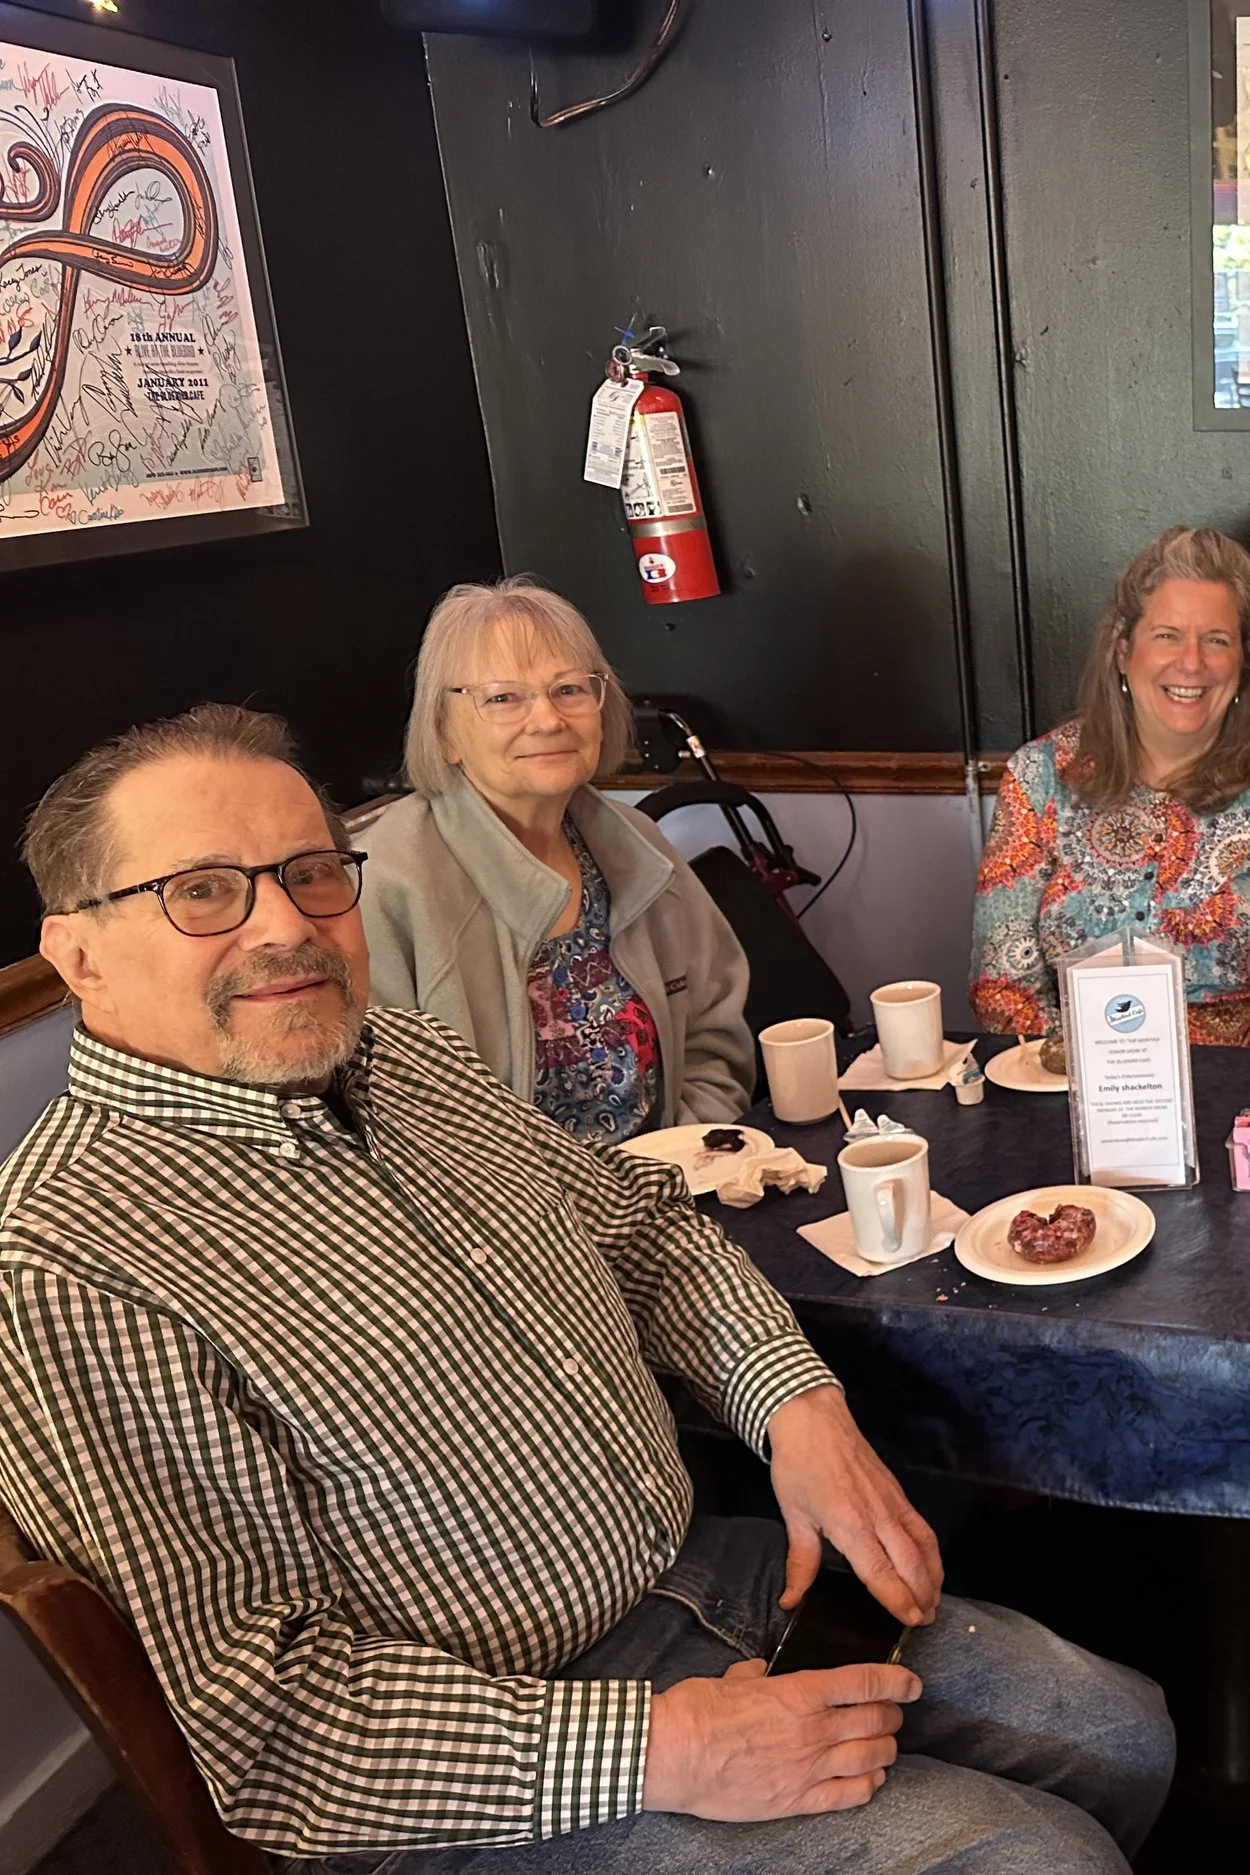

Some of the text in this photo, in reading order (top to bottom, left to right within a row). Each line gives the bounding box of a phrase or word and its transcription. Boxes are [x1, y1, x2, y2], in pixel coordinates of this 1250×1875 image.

[130, 332, 196, 343] 18th ANNUAL
[137, 378, 209, 388] JANUARY 2011
[1098, 1082, 1163, 1093] Emily shackelton
